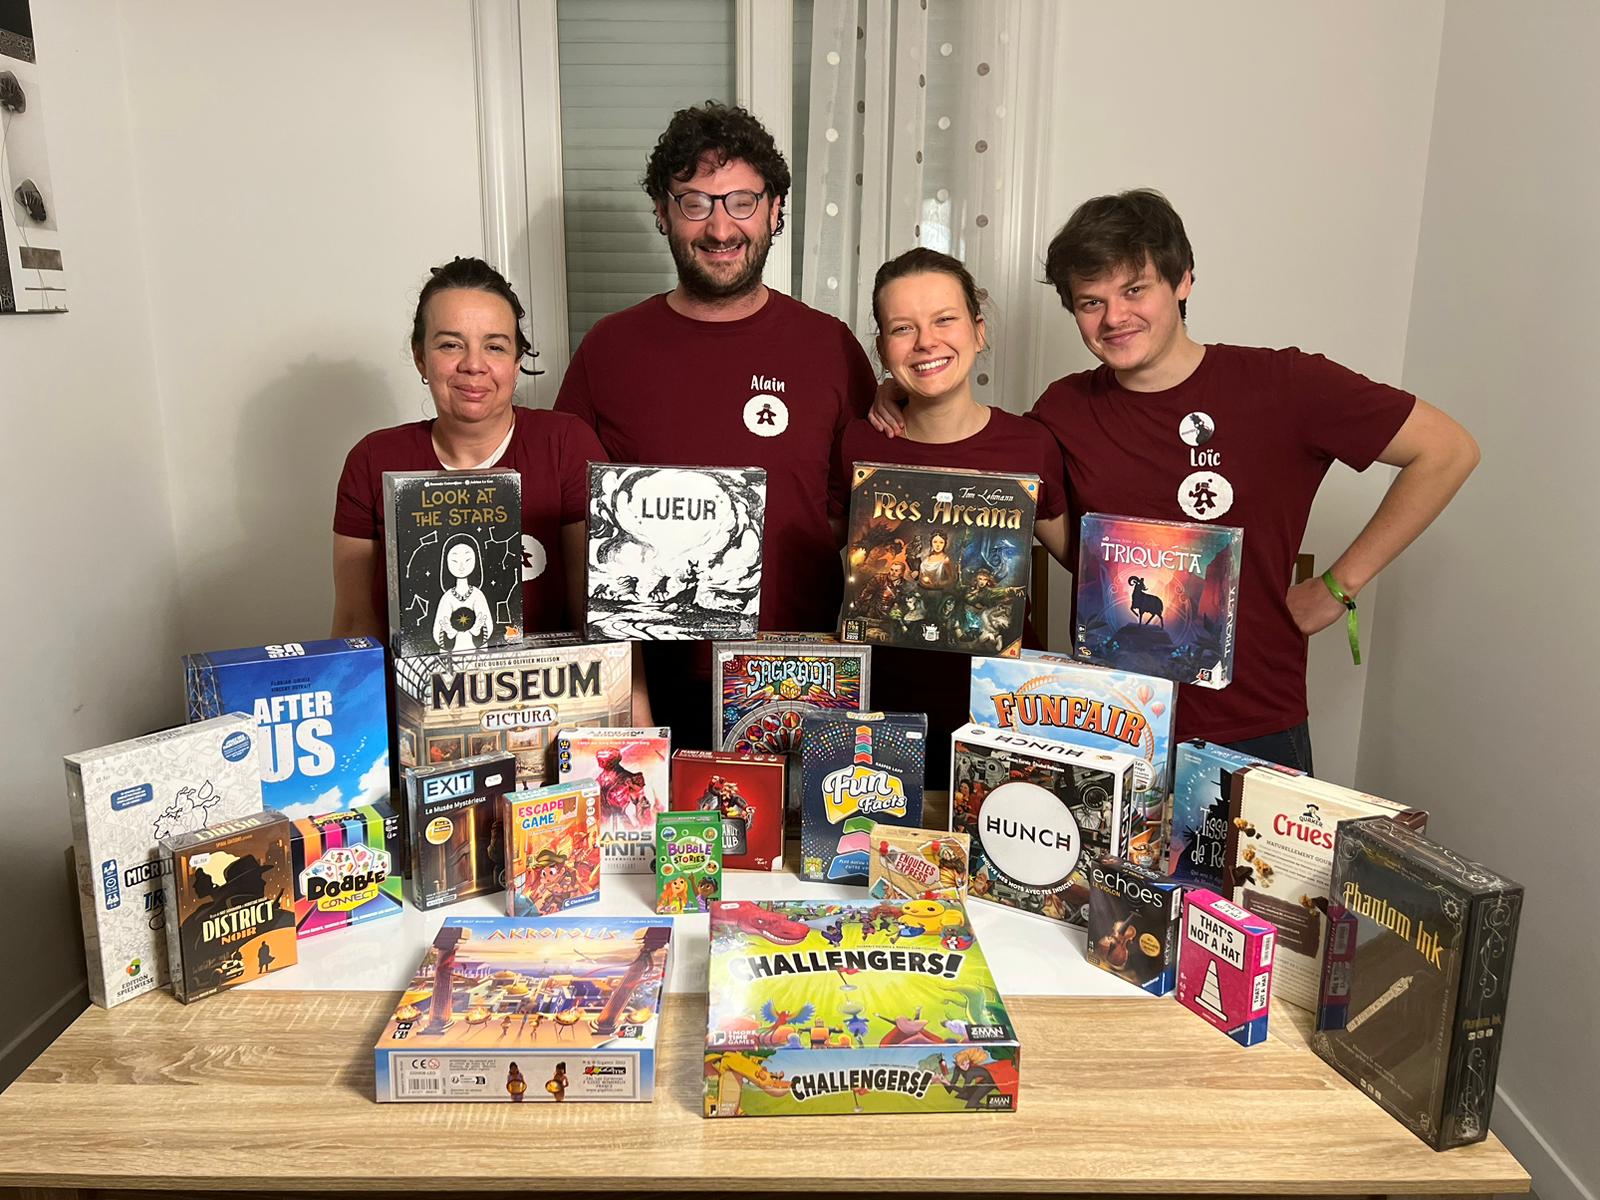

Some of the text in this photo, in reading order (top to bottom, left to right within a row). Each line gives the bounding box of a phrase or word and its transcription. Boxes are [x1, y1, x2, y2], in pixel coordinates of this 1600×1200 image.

[751, 374, 785, 392] Alain
[1190, 447, 1221, 467] Loïc
[421, 487, 497, 508] LOOK AT
[959, 486, 1014, 506] Tom Lehmann
[411, 505, 508, 527] THE STARS
[642, 497, 716, 521] LUEUR
[873, 491, 1024, 530] Res Arcana
[1101, 541, 1202, 574] TRIQUETA
[430, 660, 603, 710] MUSEUM
[746, 658, 837, 698] SAGRADA
[253, 690, 333, 725] AFTER
[486, 709, 552, 727] PICTURA
[990, 691, 1148, 748] FUNFAIR
[257, 718, 336, 783] US
[995, 735, 1084, 758] HUNCH
[427, 774, 471, 797] EXIT
[824, 764, 893, 804] Fun
[433, 802, 453, 813] Musée
[453, 796, 487, 809] Mystérieux
[518, 799, 565, 818] ESCAPE
[858, 796, 907, 814] Facts
[522, 813, 555, 829] GAME
[1200, 806, 1228, 840] Tisse
[1273, 813, 1334, 849] Crues
[1299, 815, 1323, 828] QUAKER
[600, 831, 653, 841] ARDS
[986, 815, 1071, 852] HUNCH
[667, 843, 713, 856] BUBBLE
[674, 855, 706, 864] STORIES
[1191, 833, 1205, 865] de
[1266, 840, 1332, 866] NATURELLEMENT GOUR
[894, 861, 930, 884] EXPRESS
[307, 870, 385, 901] DOBBLE
[1008, 881, 1024, 892] MOTS
[1092, 868, 1163, 908] echoes
[321, 888, 377, 910] CONNECT
[202, 899, 275, 943] DISTRICT
[1200, 914, 1234, 944] THAT'S
[1343, 881, 1412, 942] Phantom
[1416, 920, 1444, 971] Ink
[221, 926, 258, 946] NOIR
[487, 927, 621, 941] AKROPOLIS
[1190, 924, 1241, 963] NOT A HAT
[730, 950, 964, 981] CHALLENGERS!
[116, 977, 155, 998] SPIELWIESE
[121, 974, 149, 990] EDITION
[792, 1069, 933, 1101] CHALLENGERS!
